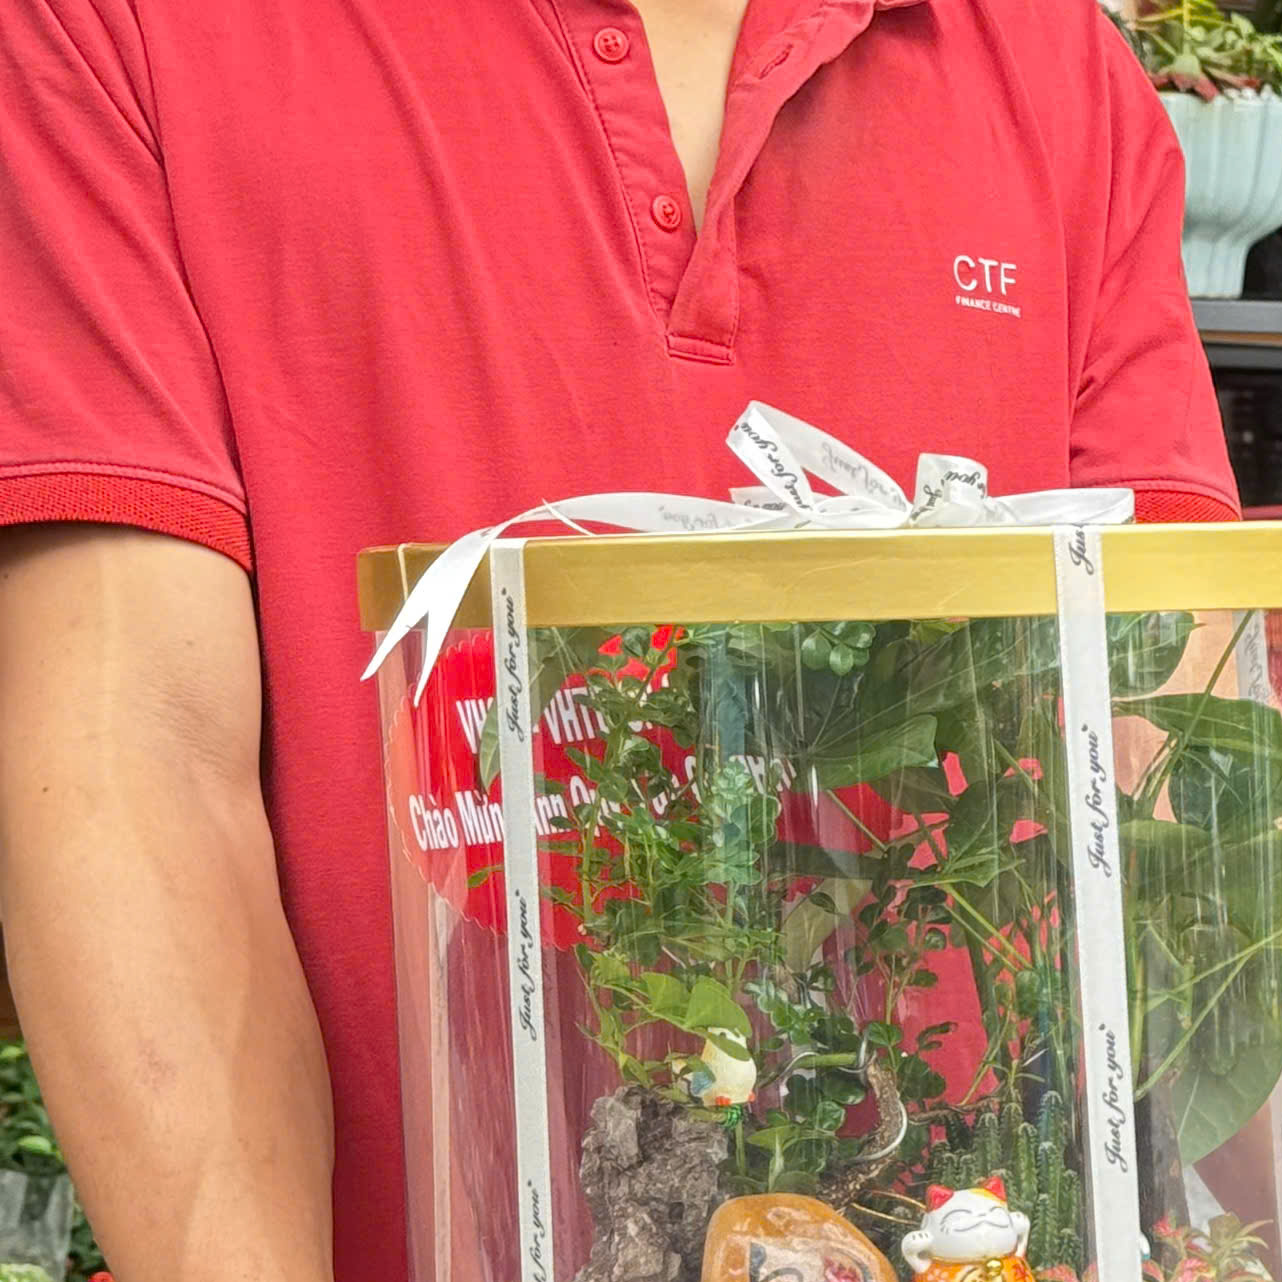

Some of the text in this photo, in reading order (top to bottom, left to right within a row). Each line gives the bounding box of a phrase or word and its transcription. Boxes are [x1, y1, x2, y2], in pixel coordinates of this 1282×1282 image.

[954, 255, 1017, 296] CTF
[1069, 524, 1094, 576] Jus
[504, 596, 525, 743] Just for you
[409, 794, 459, 851] Chào
[455, 789, 504, 845] Mừn
[1085, 730, 1111, 878] Just for you
[517, 897, 537, 1041] Just for you
[1102, 1030, 1128, 1173] Just for you
[531, 1188, 545, 1239] you
[529, 1234, 547, 1282] for
